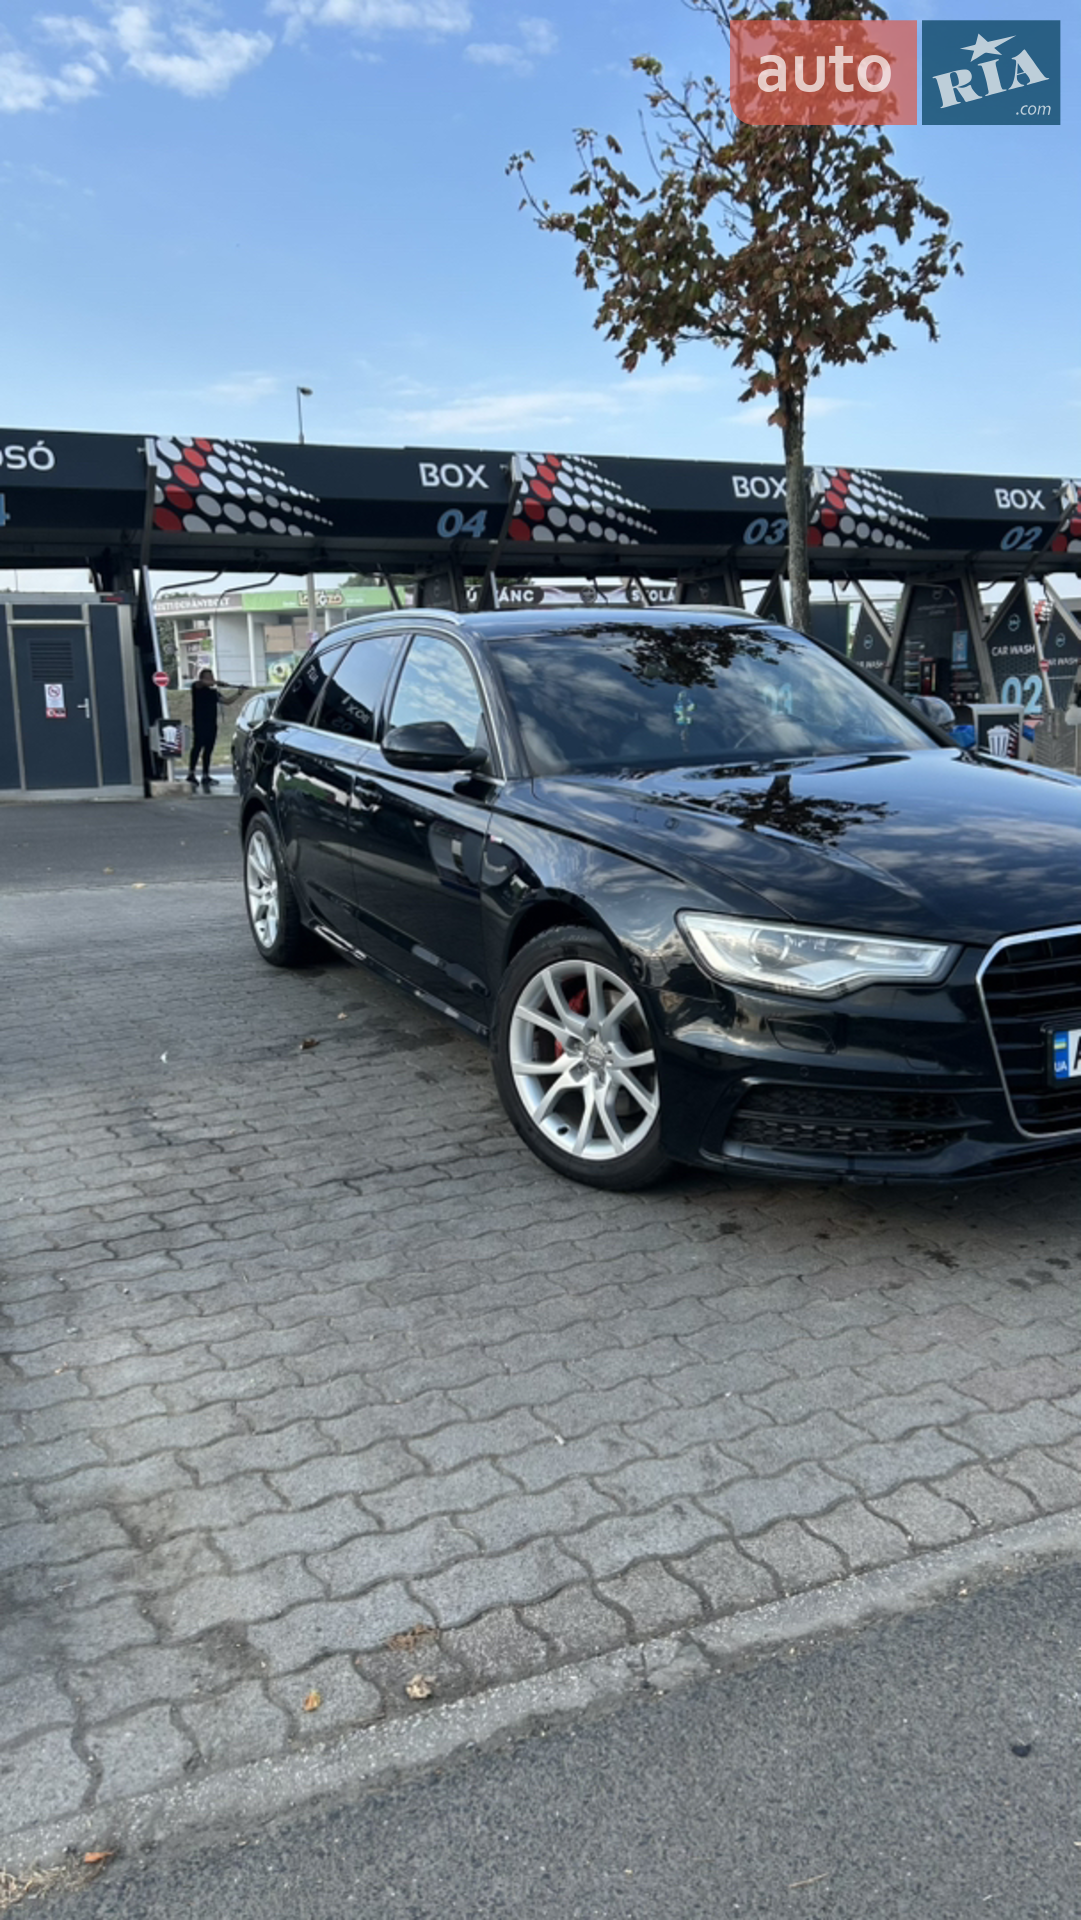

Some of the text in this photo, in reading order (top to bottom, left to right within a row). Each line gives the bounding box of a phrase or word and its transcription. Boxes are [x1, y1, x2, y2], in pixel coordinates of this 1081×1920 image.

[0, 440, 55, 471] SÓ
[419, 462, 489, 489] BOX
[732, 475, 788, 499] BOX
[994, 488, 1046, 511] BOX
[437, 508, 488, 539] 04
[743, 517, 790, 546] 03
[1001, 525, 1043, 552] 02
[991, 644, 1036, 657] CAR WASH
[1001, 674, 1043, 714] 02
[1053, 1060, 1068, 1073] UA
